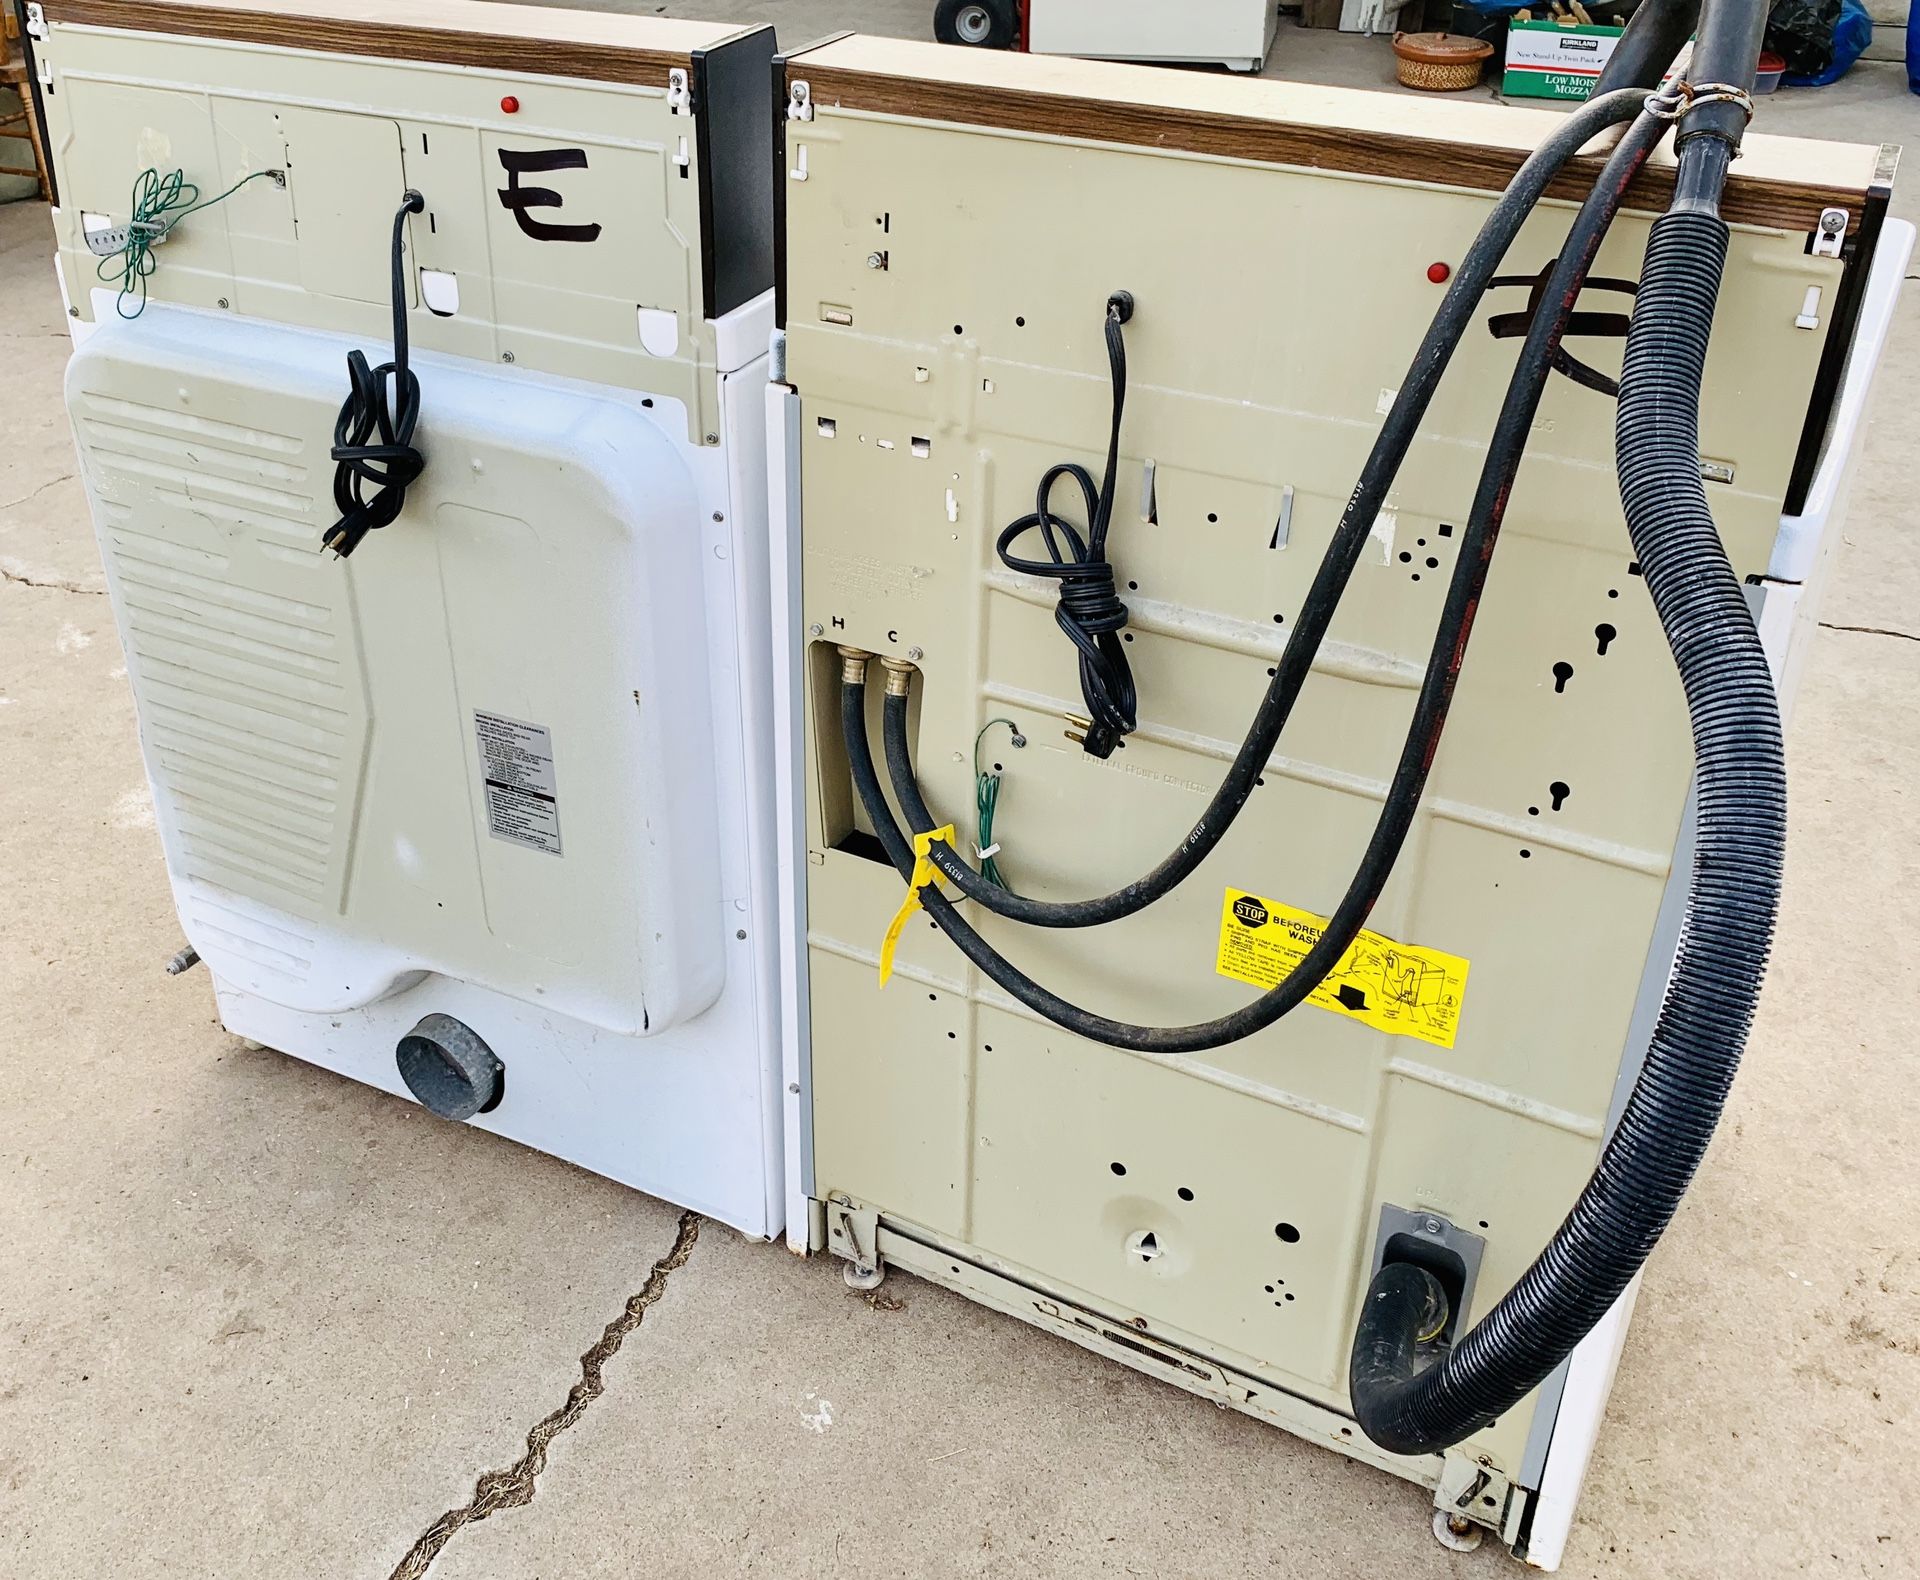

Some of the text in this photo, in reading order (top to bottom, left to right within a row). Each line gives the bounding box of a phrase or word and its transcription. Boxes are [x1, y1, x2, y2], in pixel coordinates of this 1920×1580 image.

[1562, 39, 1597, 48] KIRKLAND
[1545, 75, 1567, 85] LOW
[497, 148, 602, 242] E
[832, 615, 845, 630] H
[887, 630, 898, 643] C
[935, 851, 944, 861] H
[1236, 903, 1266, 921] STOP
